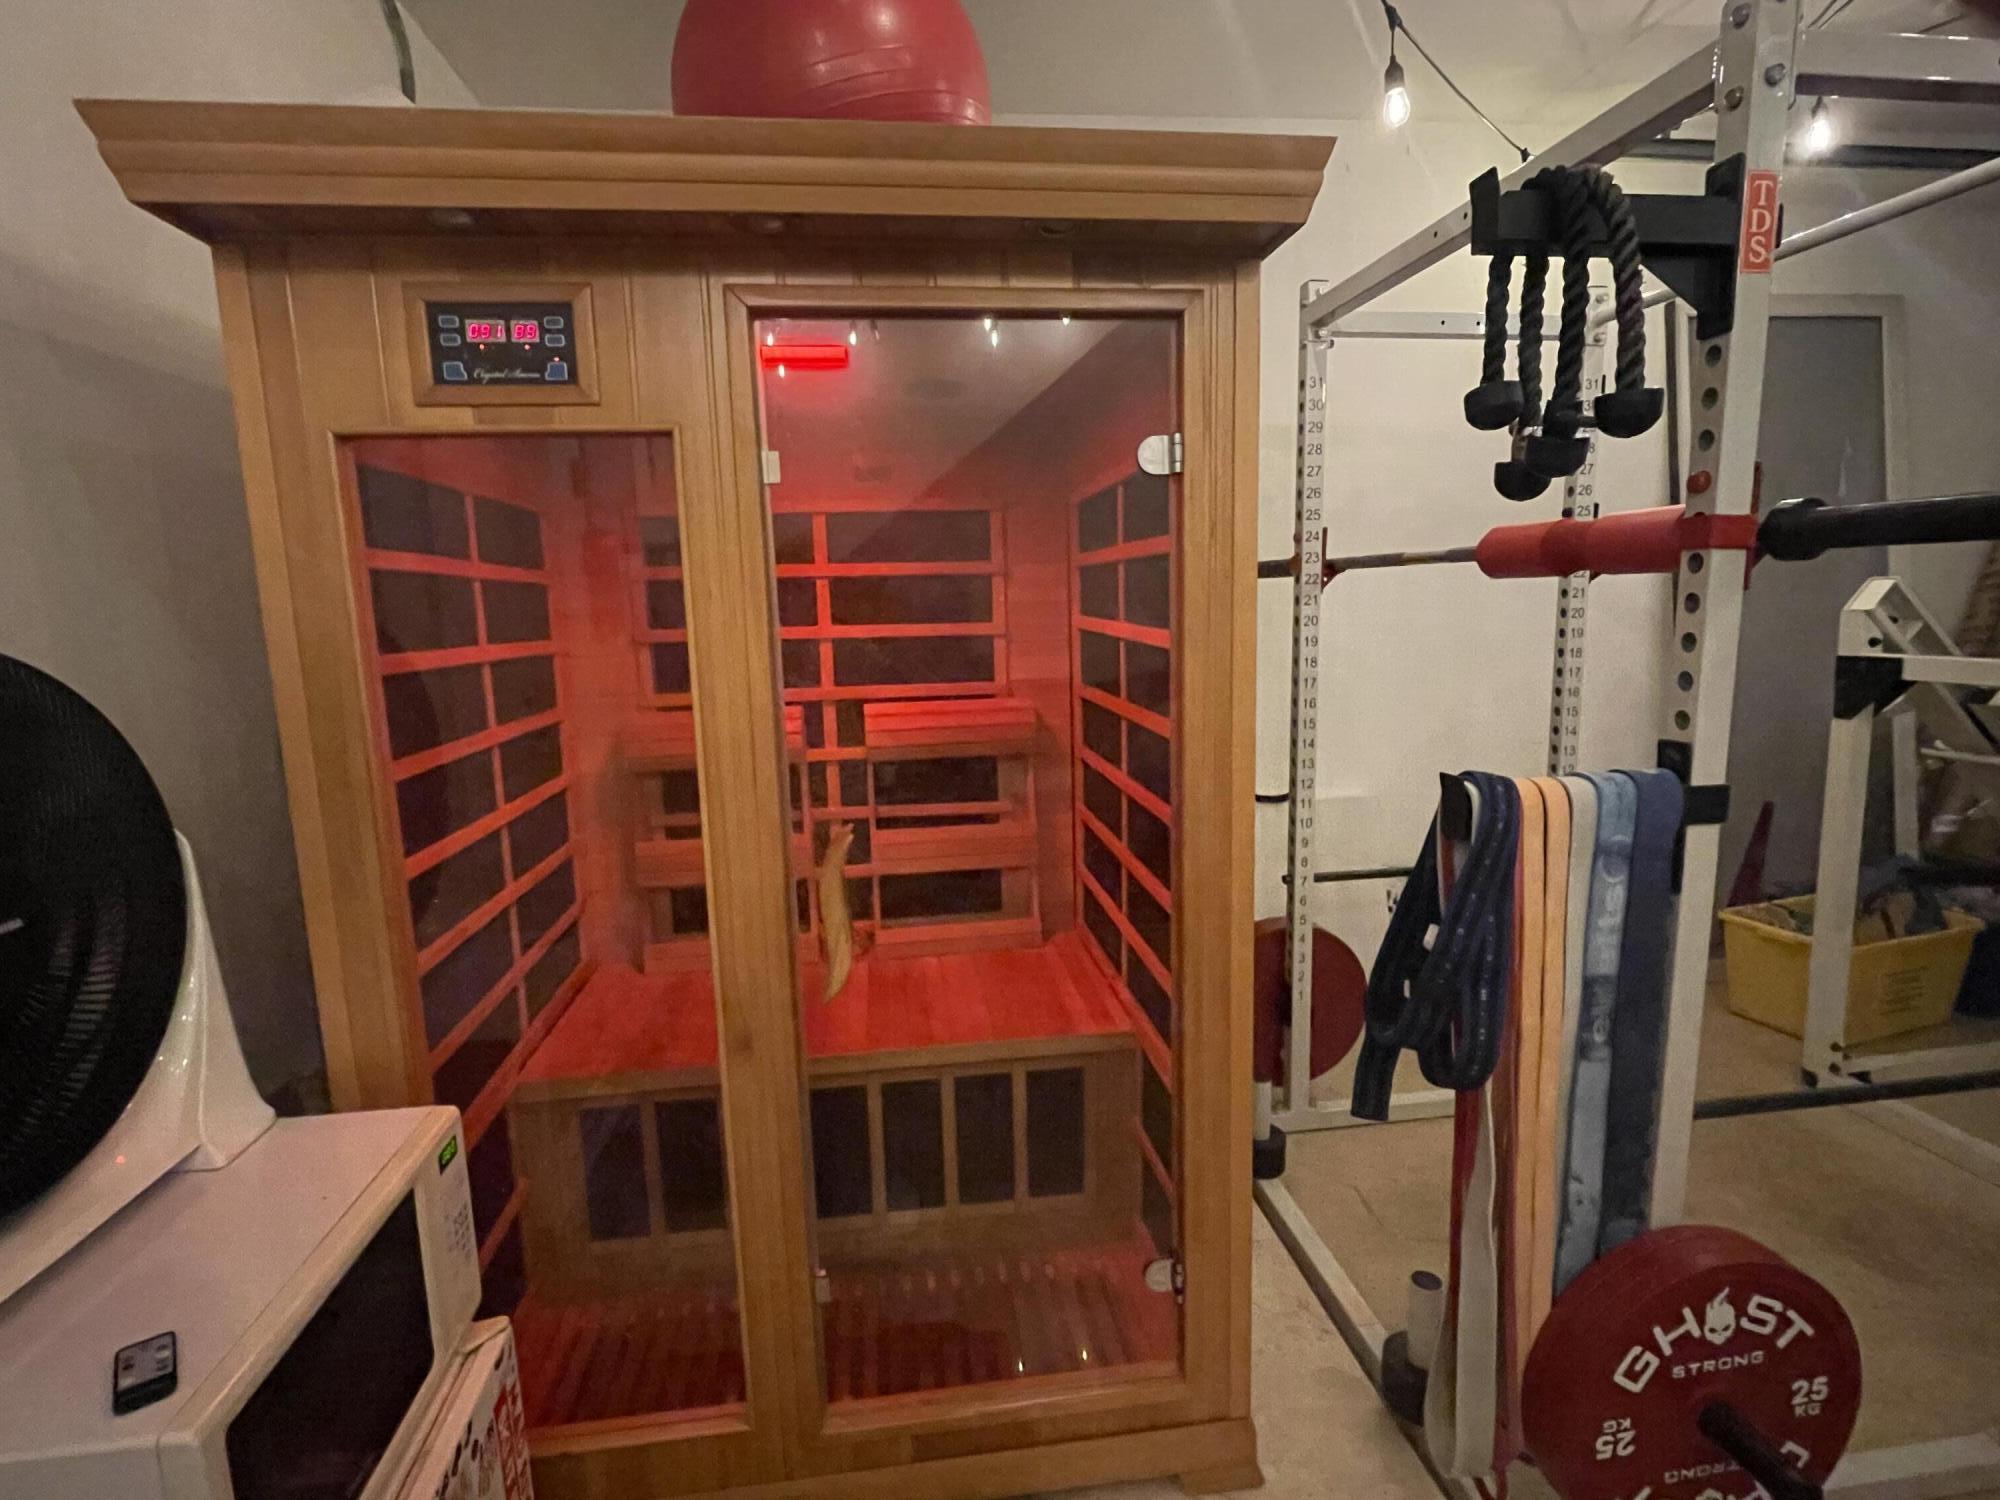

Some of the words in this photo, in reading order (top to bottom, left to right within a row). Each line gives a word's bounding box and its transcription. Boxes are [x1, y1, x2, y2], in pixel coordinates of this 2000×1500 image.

[1748, 179, 1774, 264] TDS
[1309, 376, 1323, 389] 31
[1585, 378, 1599, 390] 31
[1308, 399, 1324, 411] 30
[1308, 422, 1323, 433] 29
[1307, 444, 1322, 455] 28
[1306, 466, 1321, 477] 27
[1579, 464, 1593, 475] 27
[1306, 488, 1321, 499] 26
[1578, 485, 1592, 496] 26
[1305, 509, 1321, 521] 25
[1577, 505, 1591, 516] 25
[1304, 531, 1320, 542] 24
[1304, 552, 1320, 564] 23
[1304, 573, 1320, 585] 22
[1572, 587, 1585, 599] 21
[1304, 594, 1318, 606] 21
[1571, 607, 1584, 618] 20
[1303, 615, 1318, 627] 20
[1571, 627, 1583, 638] 19
[1304, 636, 1318, 647] 19
[1570, 647, 1582, 658] 18
[1304, 657, 1317, 668] 18
[1569, 667, 1581, 677] 17
[1303, 677, 1317, 688] 17
[1303, 698, 1316, 709] 16
[1566, 706, 1578, 716] 15
[1303, 718, 1316, 729] 15
[1565, 725, 1577, 735] 14
[1303, 738, 1315, 749] 14
[1563, 745, 1576, 756] 13
[1302, 758, 1314, 769] 13
[1301, 778, 1314, 789] 12
[1301, 798, 1312, 808] 11
[1300, 817, 1313, 829] 10
[1671, 1350, 1765, 1380] STRONG
[1791, 1375, 1830, 1406] 25
[1794, 1403, 1822, 1418] KG
[1602, 1417, 1632, 1434] KG
[1595, 1430, 1637, 1461] 25
[1663, 1460, 1745, 1484] TRONG
